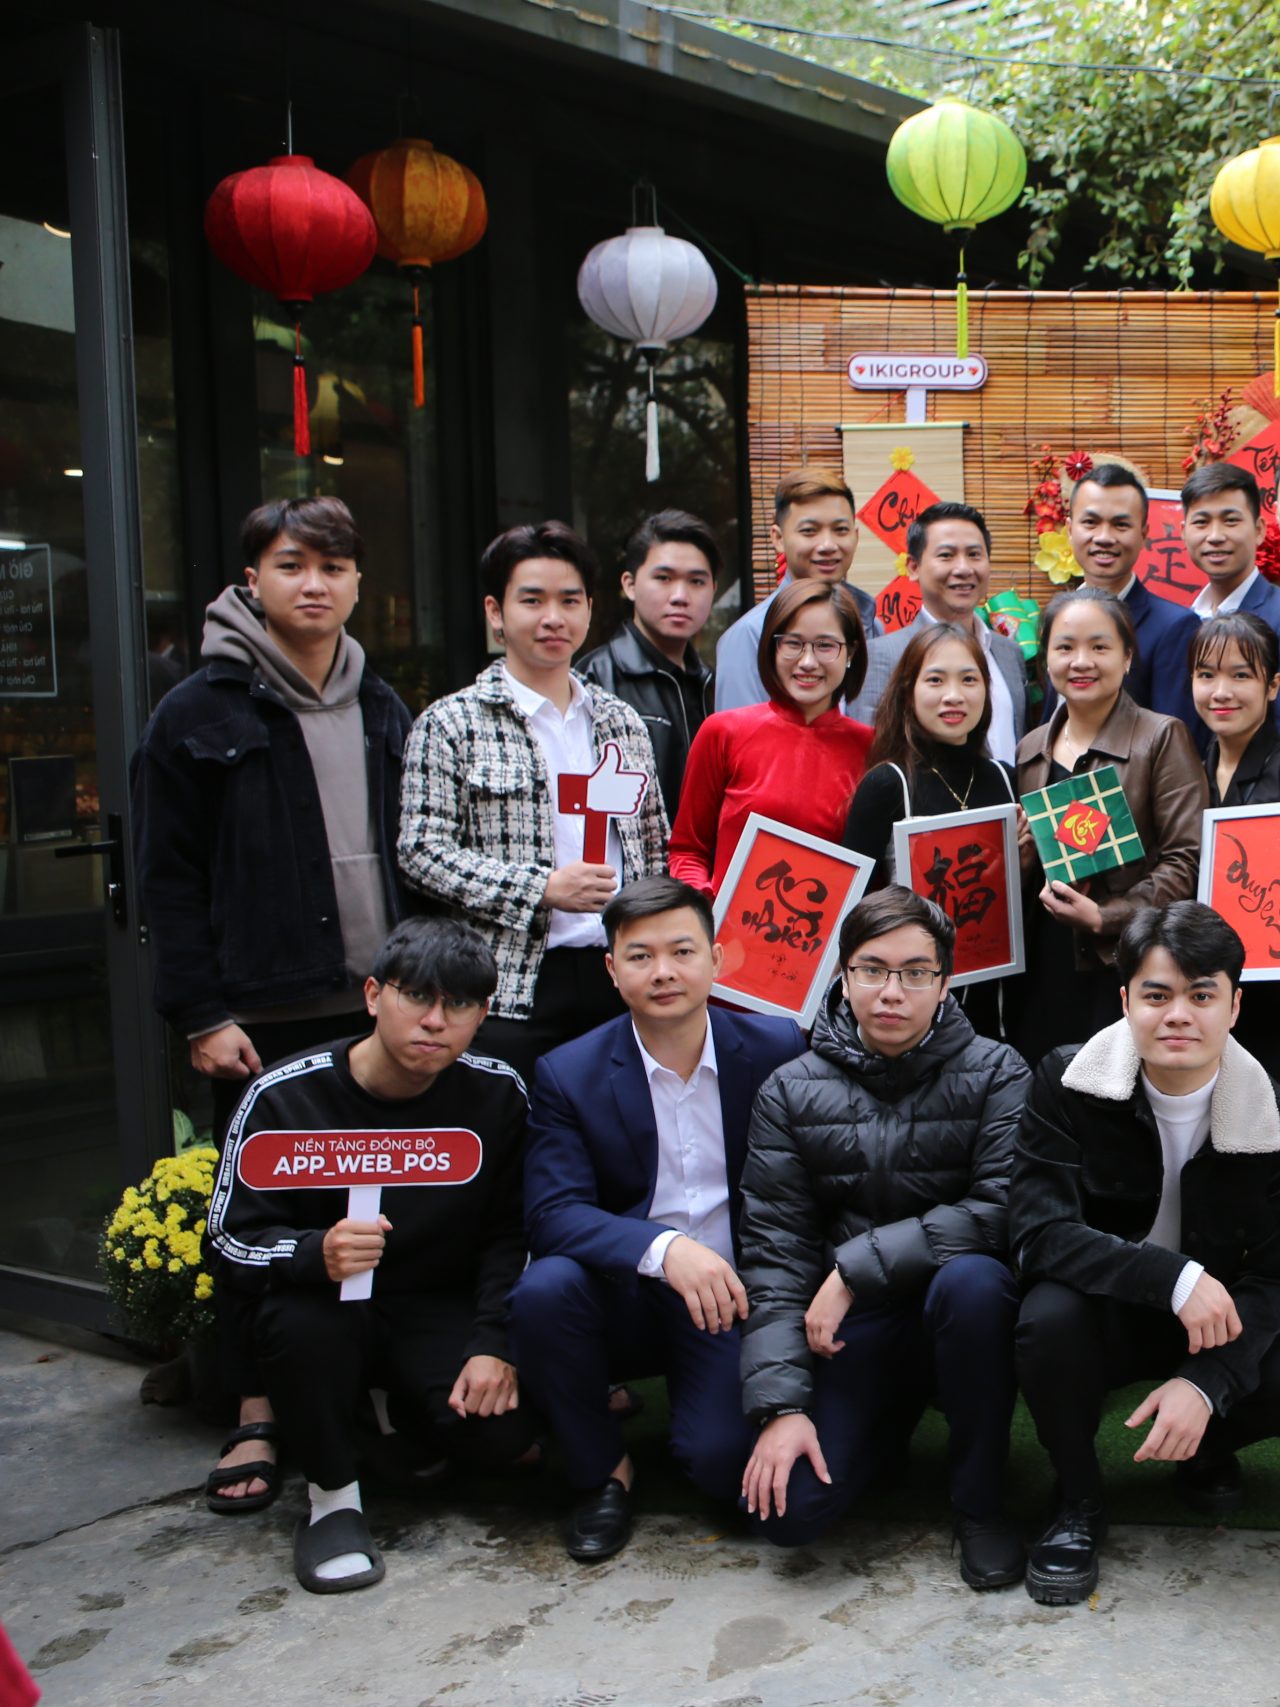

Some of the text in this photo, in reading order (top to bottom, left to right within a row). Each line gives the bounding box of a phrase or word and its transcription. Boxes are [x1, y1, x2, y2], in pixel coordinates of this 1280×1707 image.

[869, 363, 965, 378] IKIGROUP
[294, 1136, 436, 1153] NỀN TẢNG ĐỒNG BỘ
[272, 1153, 451, 1176] APP_WEB_POS
